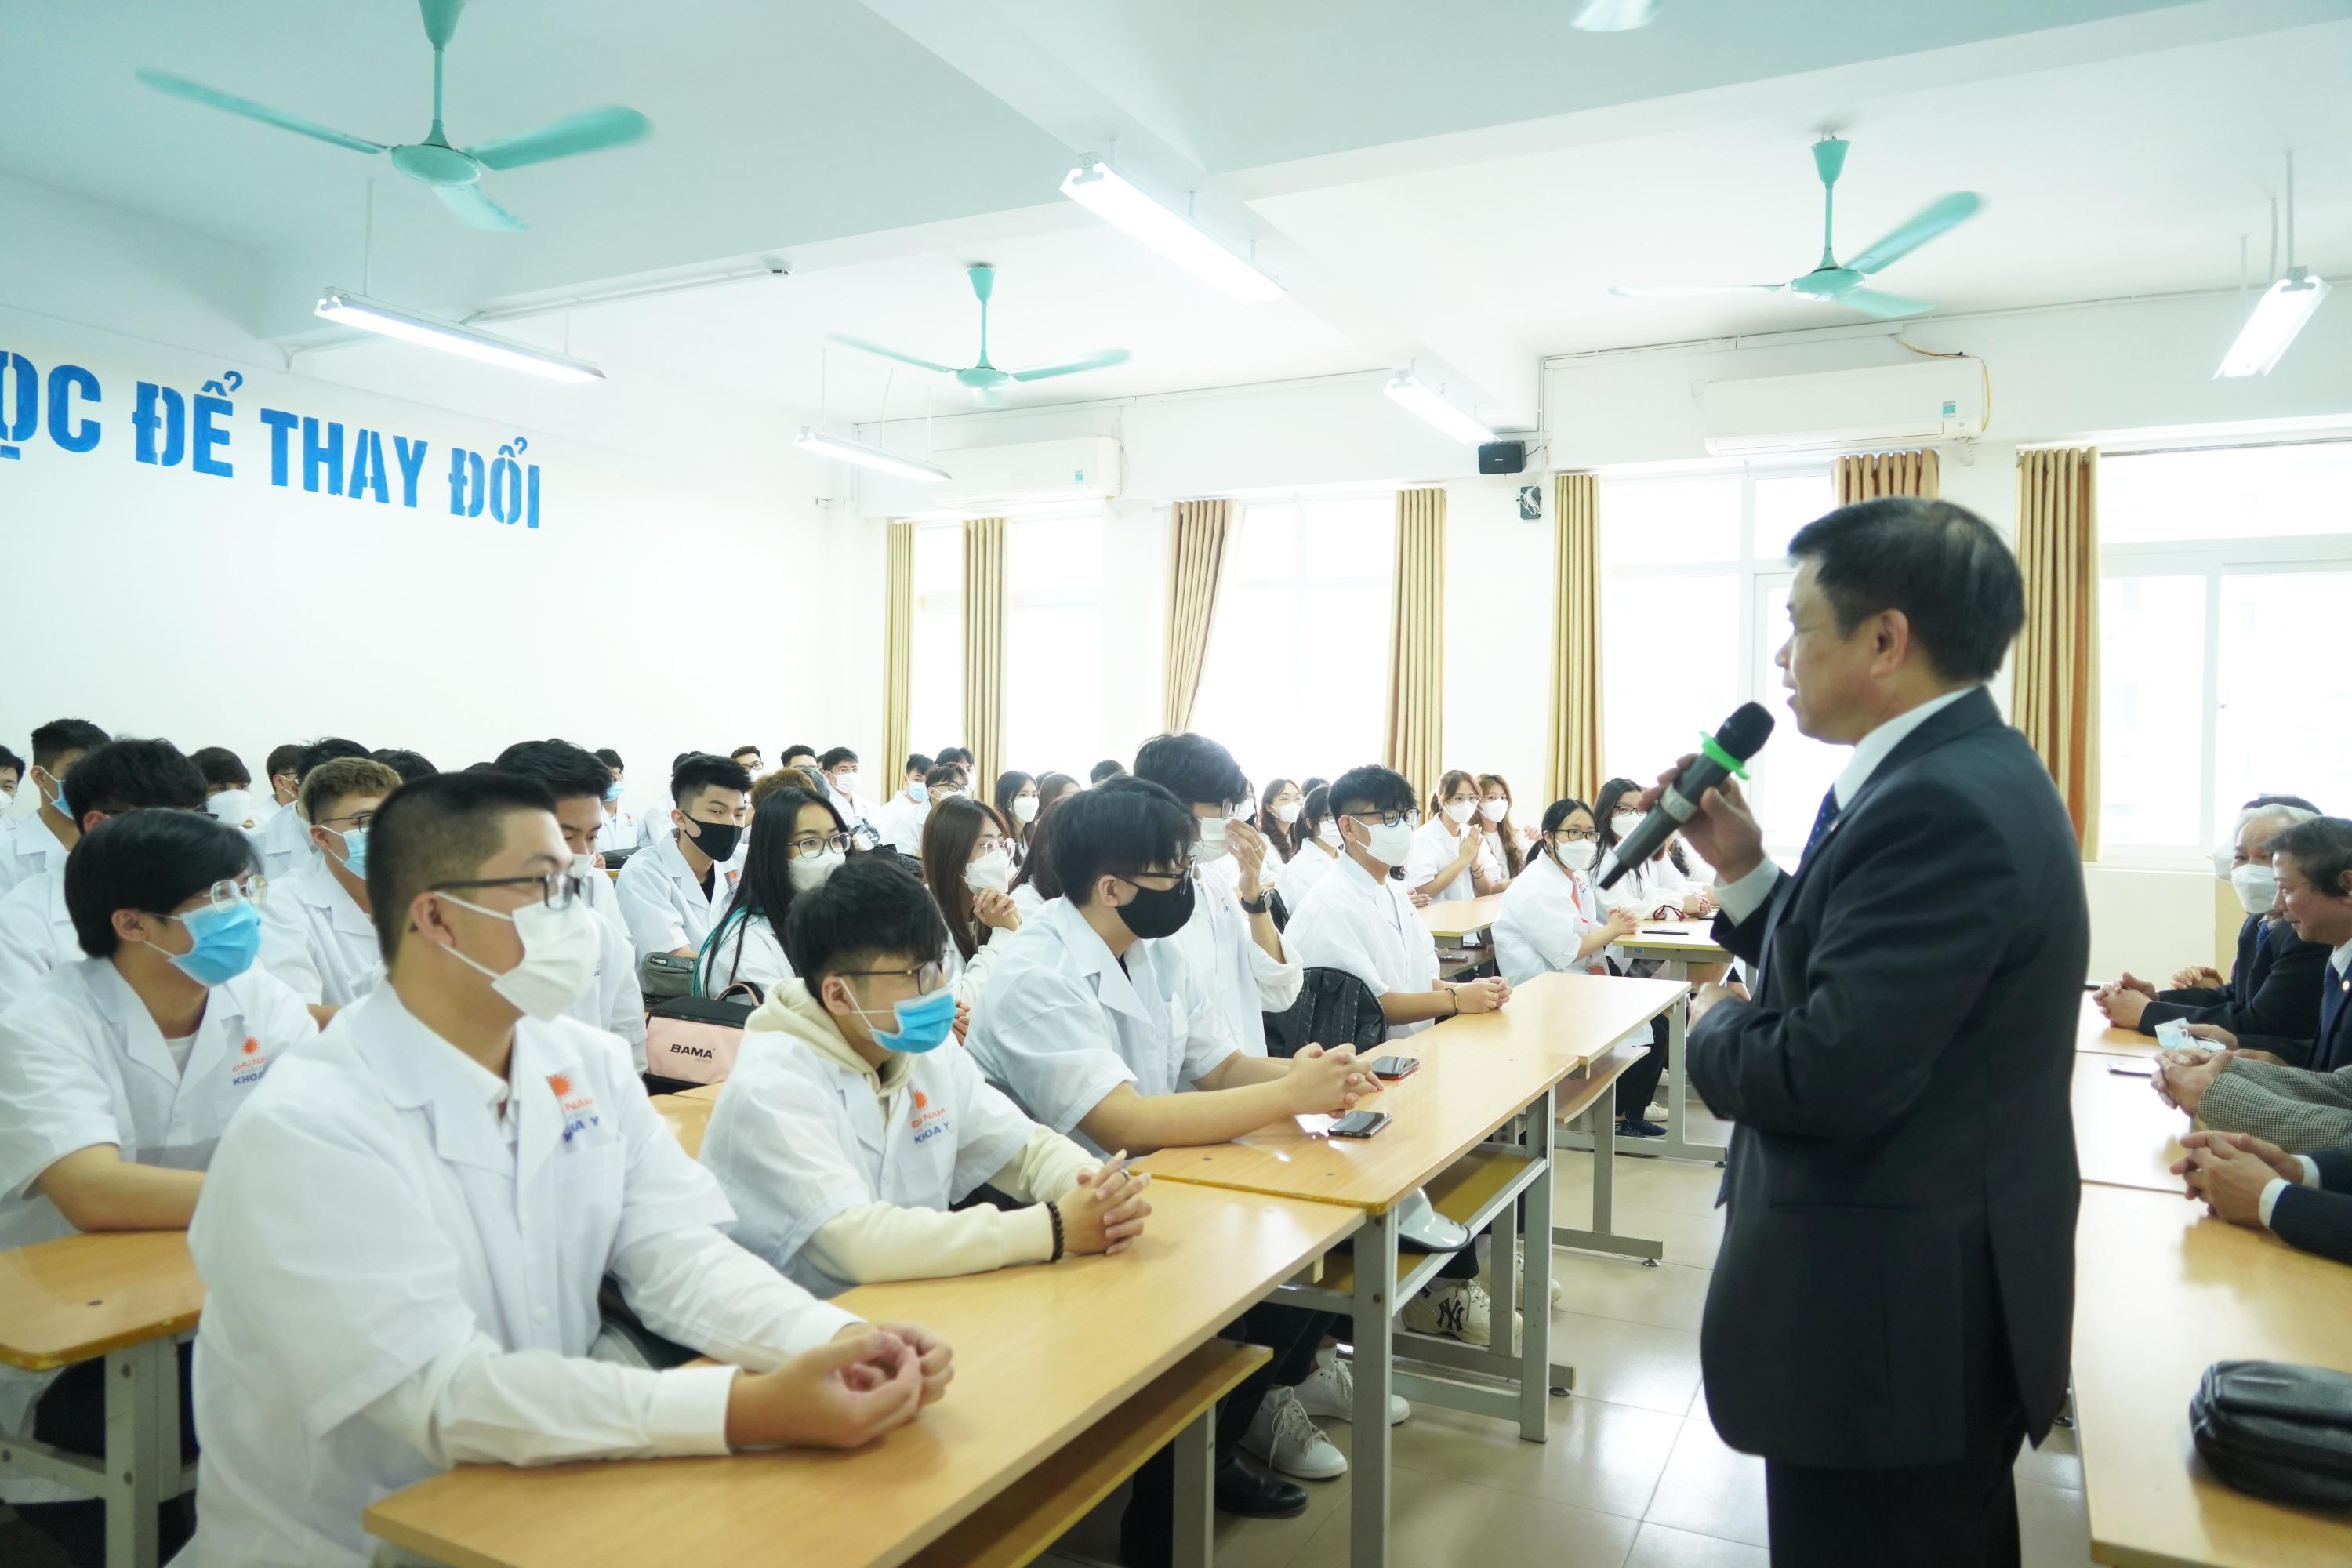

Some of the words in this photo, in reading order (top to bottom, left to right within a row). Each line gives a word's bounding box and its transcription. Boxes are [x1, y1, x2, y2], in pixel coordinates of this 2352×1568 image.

[132, 370, 244, 478] ĐỂ
[260, 408, 429, 509] THAY
[448, 436, 541, 529] ĐỔI
[670, 1044, 713, 1059] BAMA
[589, 1115, 599, 1127] Y
[942, 1120, 949, 1130] Y
